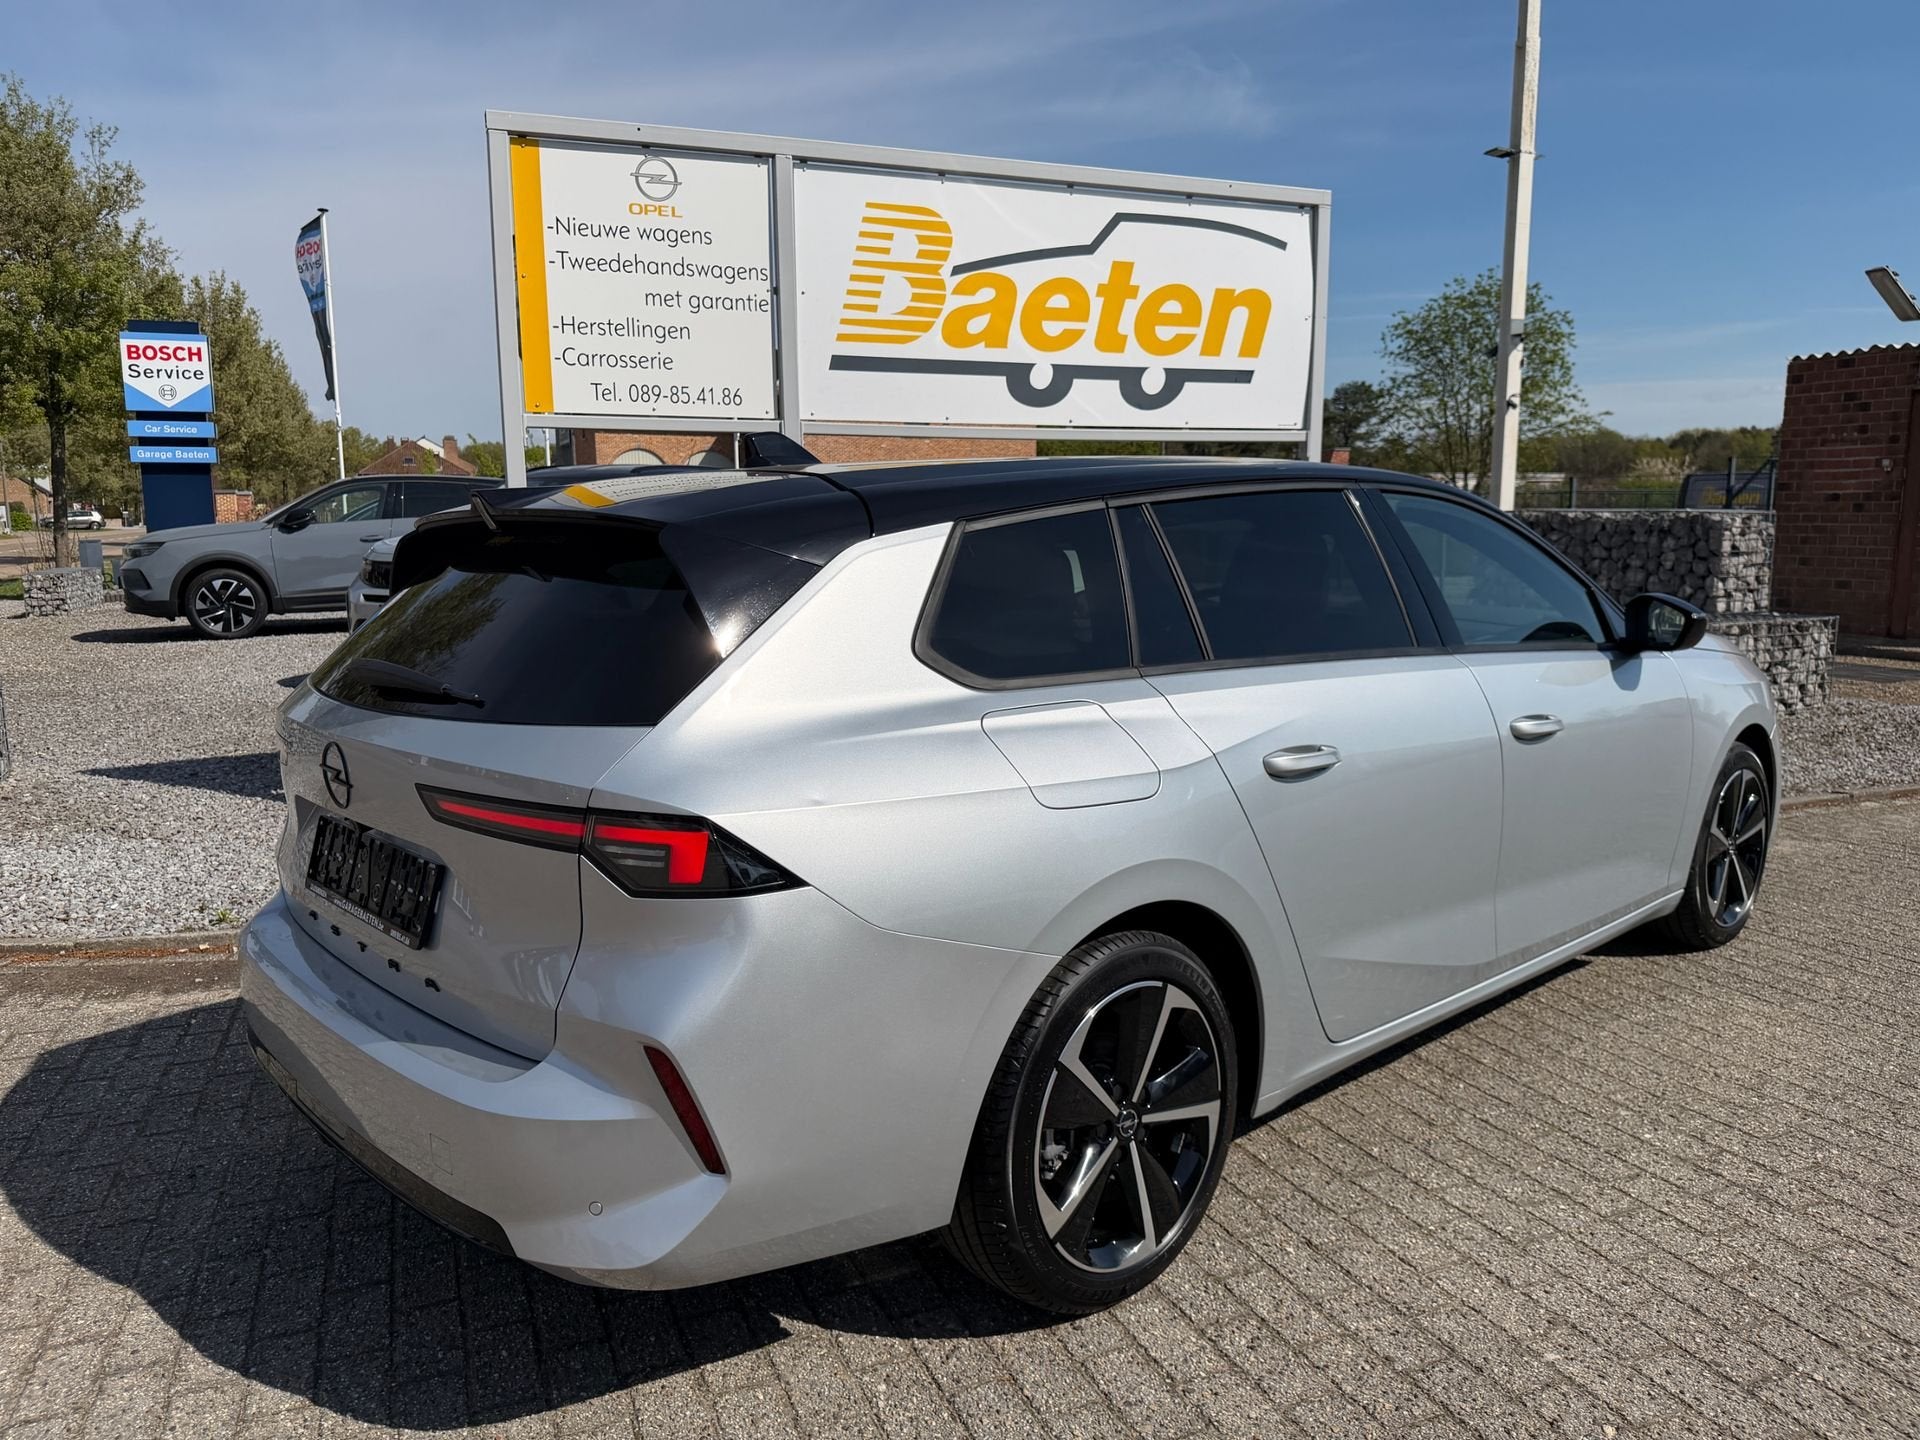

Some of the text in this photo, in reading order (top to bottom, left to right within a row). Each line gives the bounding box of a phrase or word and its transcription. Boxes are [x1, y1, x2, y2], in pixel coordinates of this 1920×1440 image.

[628, 203, 683, 218] OPEL
[547, 216, 713, 248] -Nieuwe wagens
[548, 250, 769, 285] -Tweedehandswagens
[835, 201, 1273, 359] Baeten
[645, 290, 769, 314] met garantie
[552, 315, 691, 344] -Herstellingen
[126, 344, 203, 362] BOSCH
[554, 346, 674, 370] -Carrosserie
[128, 363, 205, 380] Service
[590, 382, 743, 407] Tel. 089-85.41.86
[145, 424, 198, 434] Car Service
[137, 449, 210, 459] Garage Baeten
